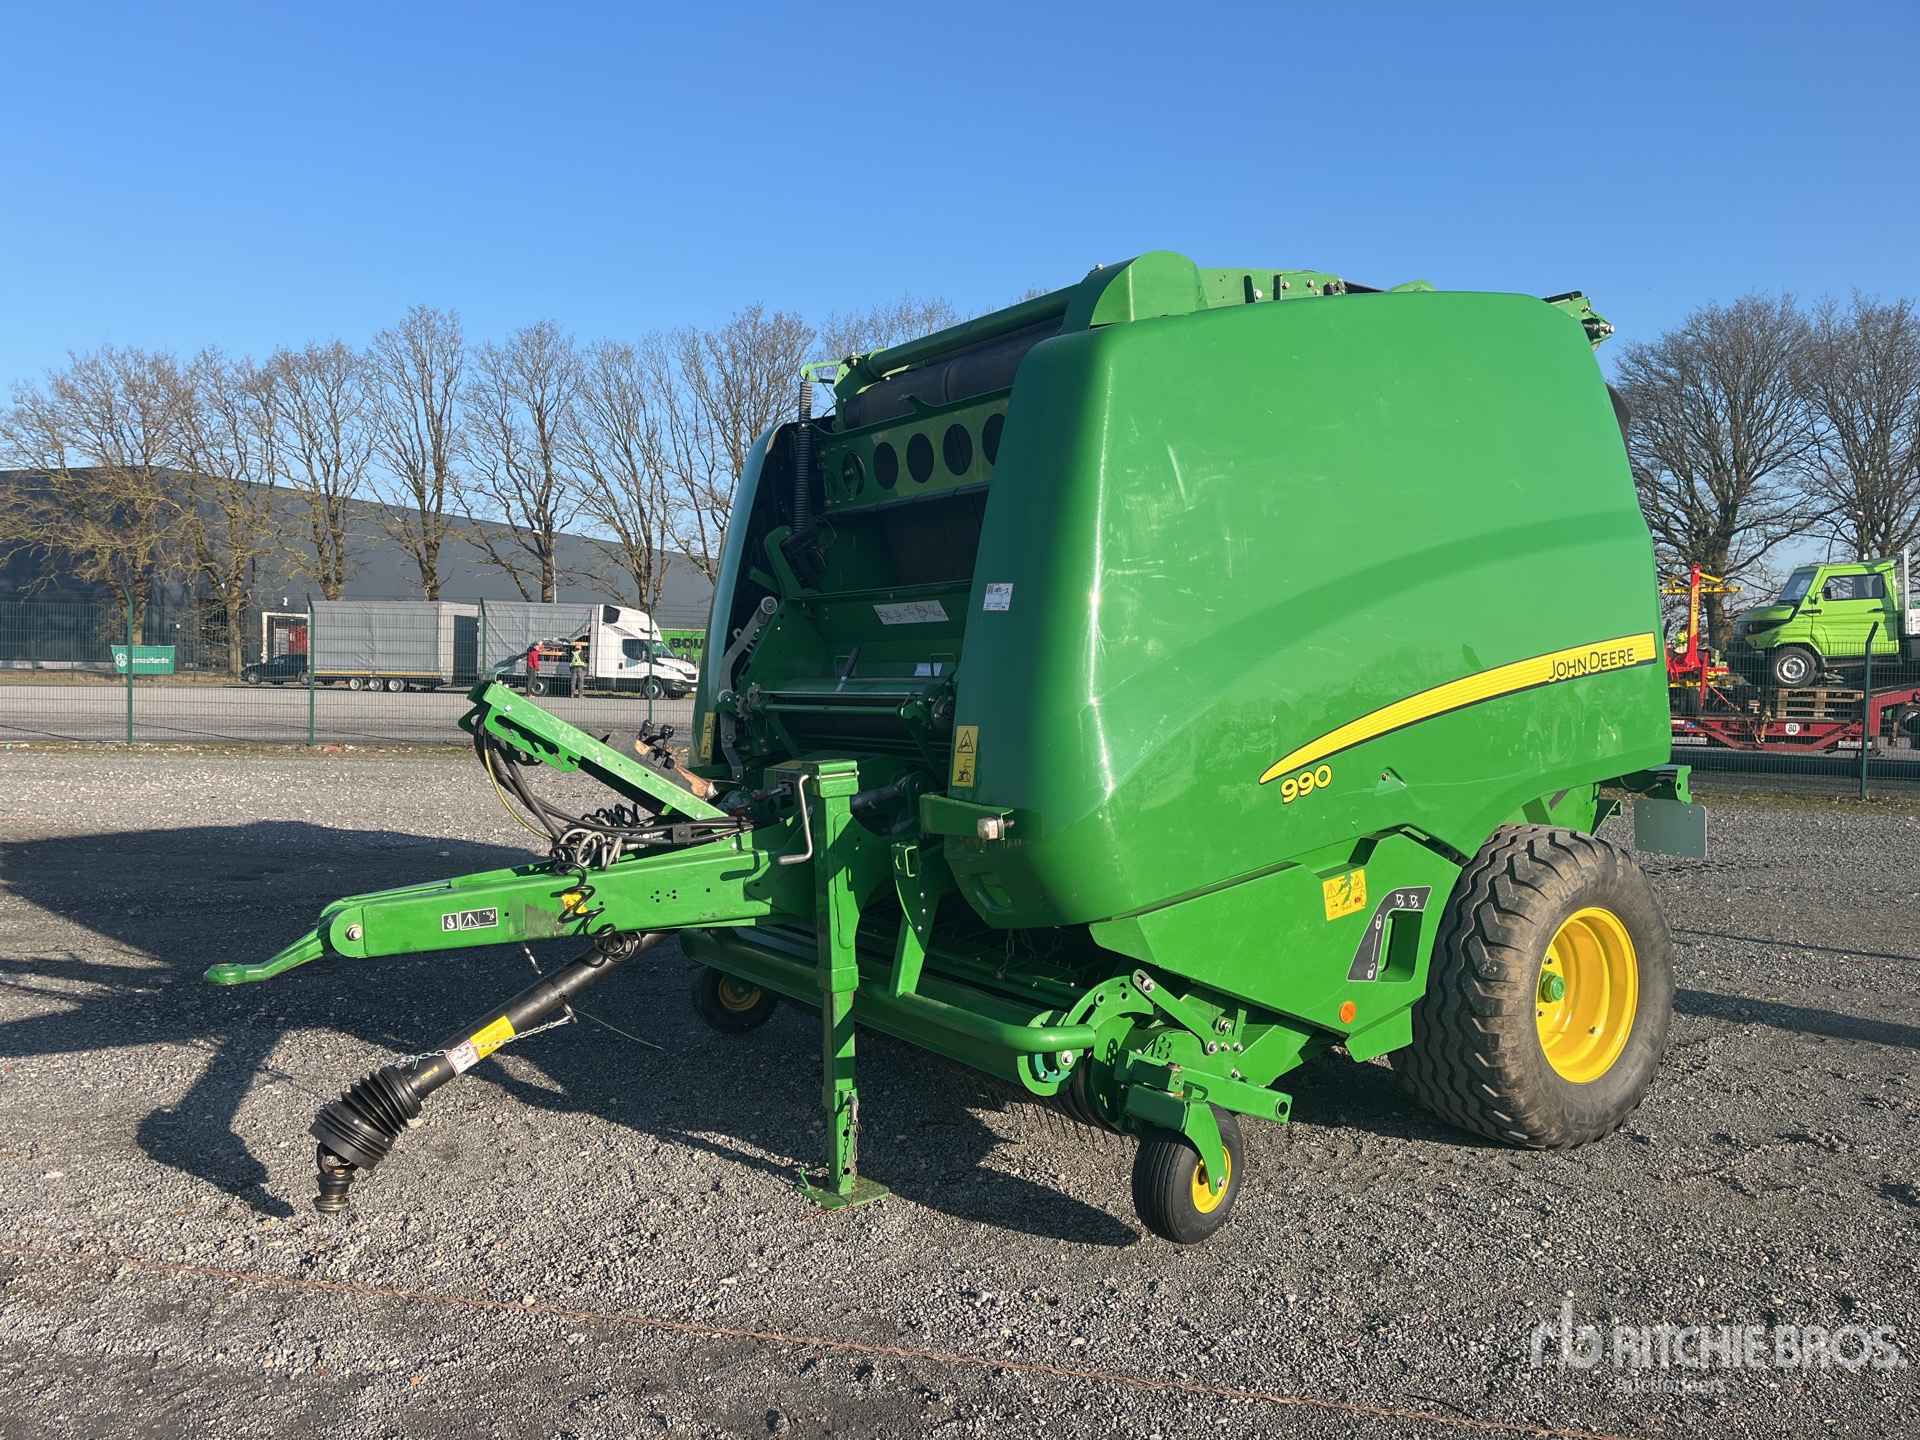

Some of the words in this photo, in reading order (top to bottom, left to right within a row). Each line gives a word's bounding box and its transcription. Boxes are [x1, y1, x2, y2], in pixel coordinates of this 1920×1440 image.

[282, 596, 288, 606] 2
[1548, 656, 1588, 680] JOHN
[1589, 647, 1635, 670] DEERE
[1787, 724, 1797, 732] 80
[1280, 763, 1333, 804] 990
